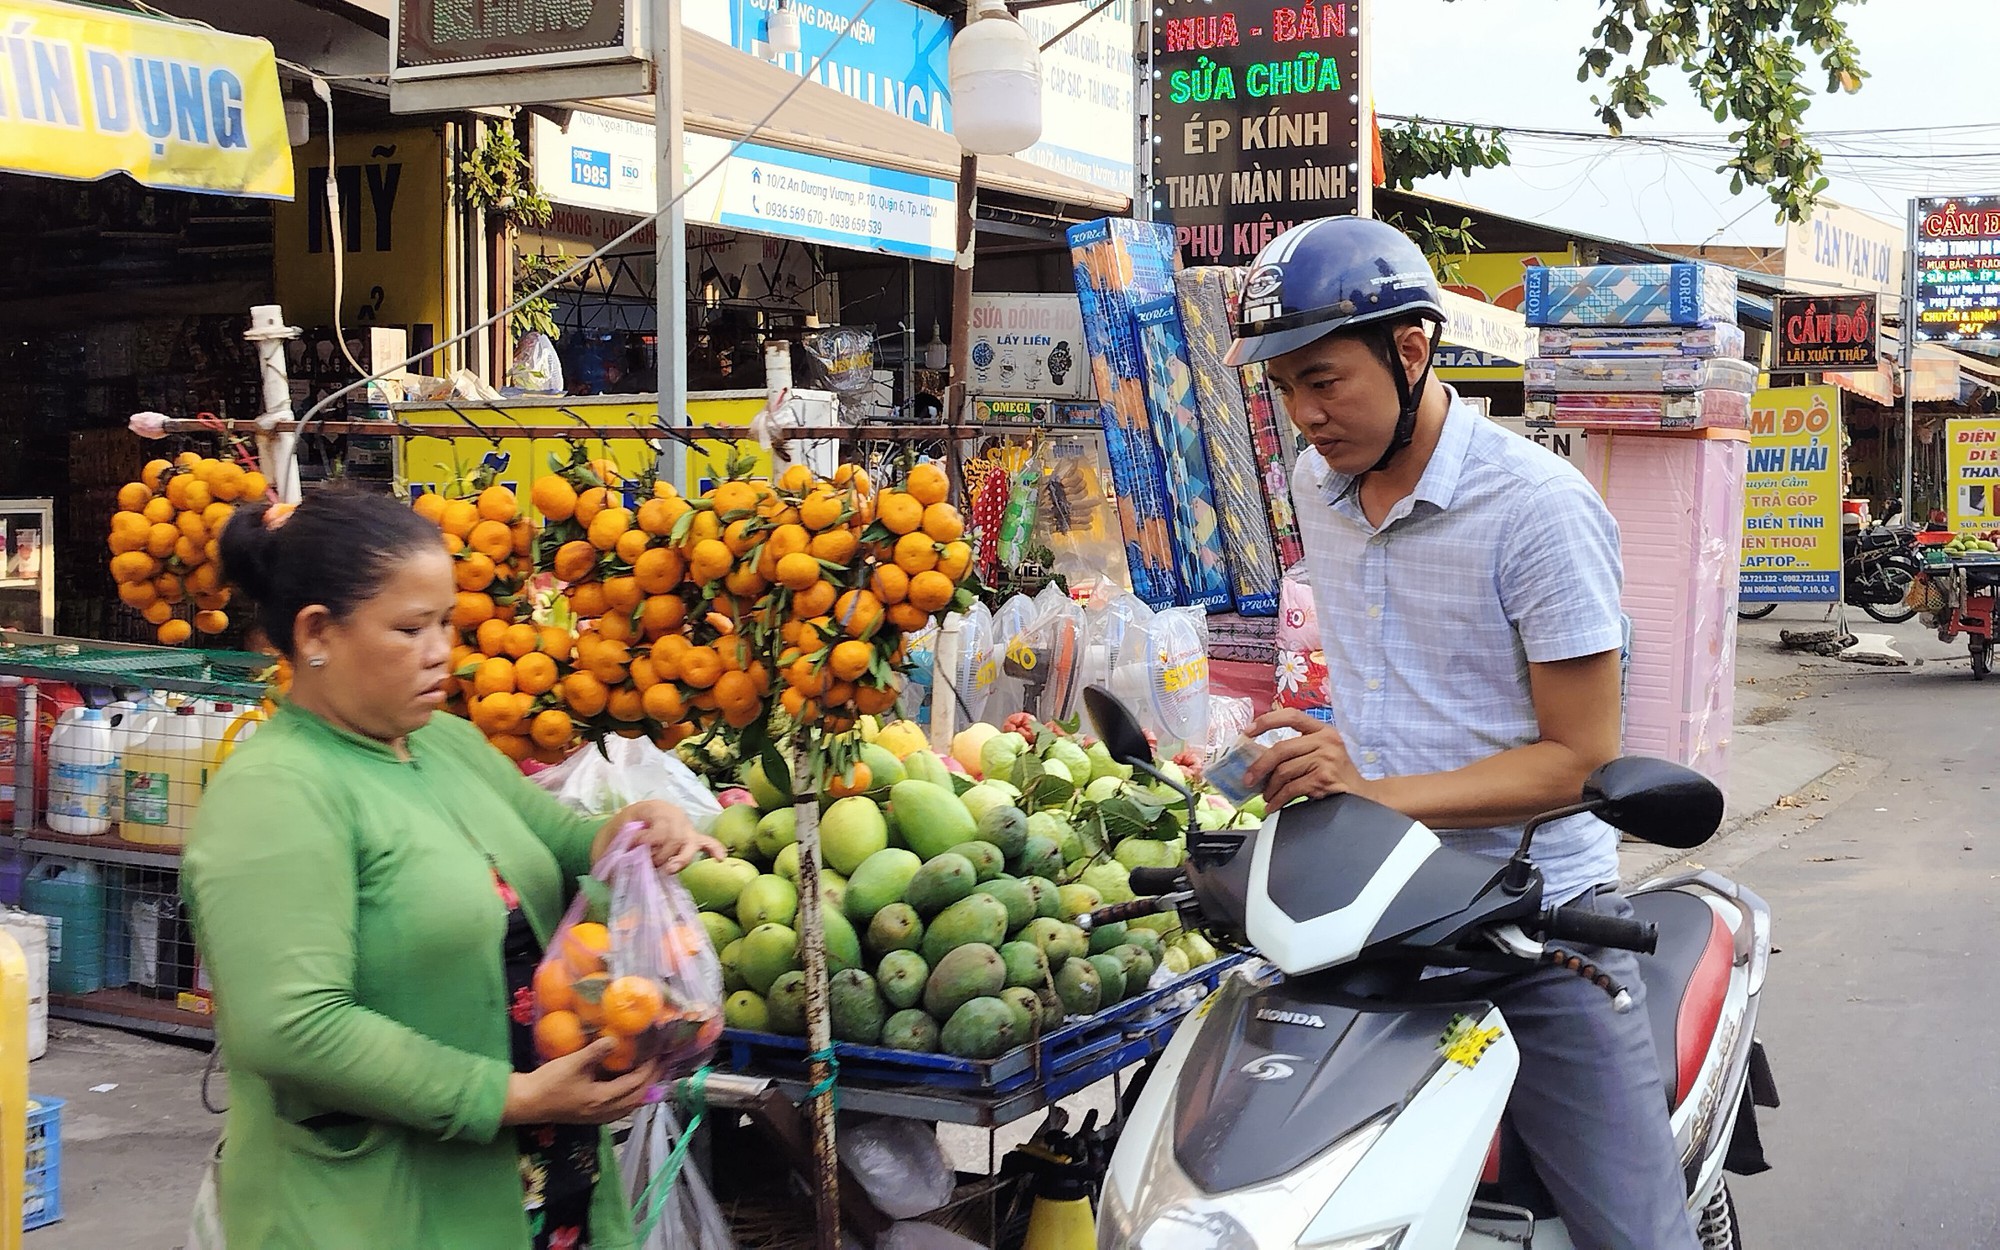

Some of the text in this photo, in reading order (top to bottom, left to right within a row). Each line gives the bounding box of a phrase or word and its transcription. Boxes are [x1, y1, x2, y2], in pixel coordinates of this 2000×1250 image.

[1167, 13, 1240, 52] MUA
[1273, 0, 1346, 43] BÁN
[0, 20, 248, 155] ÍN DỤNG
[1169, 56, 1236, 104] SỬA
[1246, 51, 1340, 98] CHỮA
[1184, 107, 1328, 154] ÉP KÍNH
[575, 162, 608, 187] 1985
[622, 165, 639, 179] ISO
[767, 174, 785, 190] 10/2
[787, 178, 799, 191] An
[1165, 159, 1346, 209] THAY MÀN HÌNH
[766, 202, 787, 218] 0936
[790, 206, 805, 221] 569
[808, 209, 822, 225] 670
[830, 213, 850, 229] 0938
[852, 217, 866, 232] 659
[868, 219, 882, 234] 539
[1176, 224, 1224, 263] PHỤ
[1814, 211, 1842, 269] TÂN
[1528, 268, 1541, 319] KOREA
[1679, 267, 1692, 316] KOREA
[973, 301, 1003, 329] SỬA
[992, 402, 1031, 413] OMEGA
[1781, 395, 1831, 435] ĐỒ
[1790, 438, 1829, 471] HẢI
[1969, 450, 1986, 460] DI
[1745, 477, 1778, 490] uyên
[1751, 491, 1818, 507] TRẢ GÓP
[1741, 534, 1817, 552] IỆN THOẠI
[1256, 1008, 1326, 1029] HONDA
